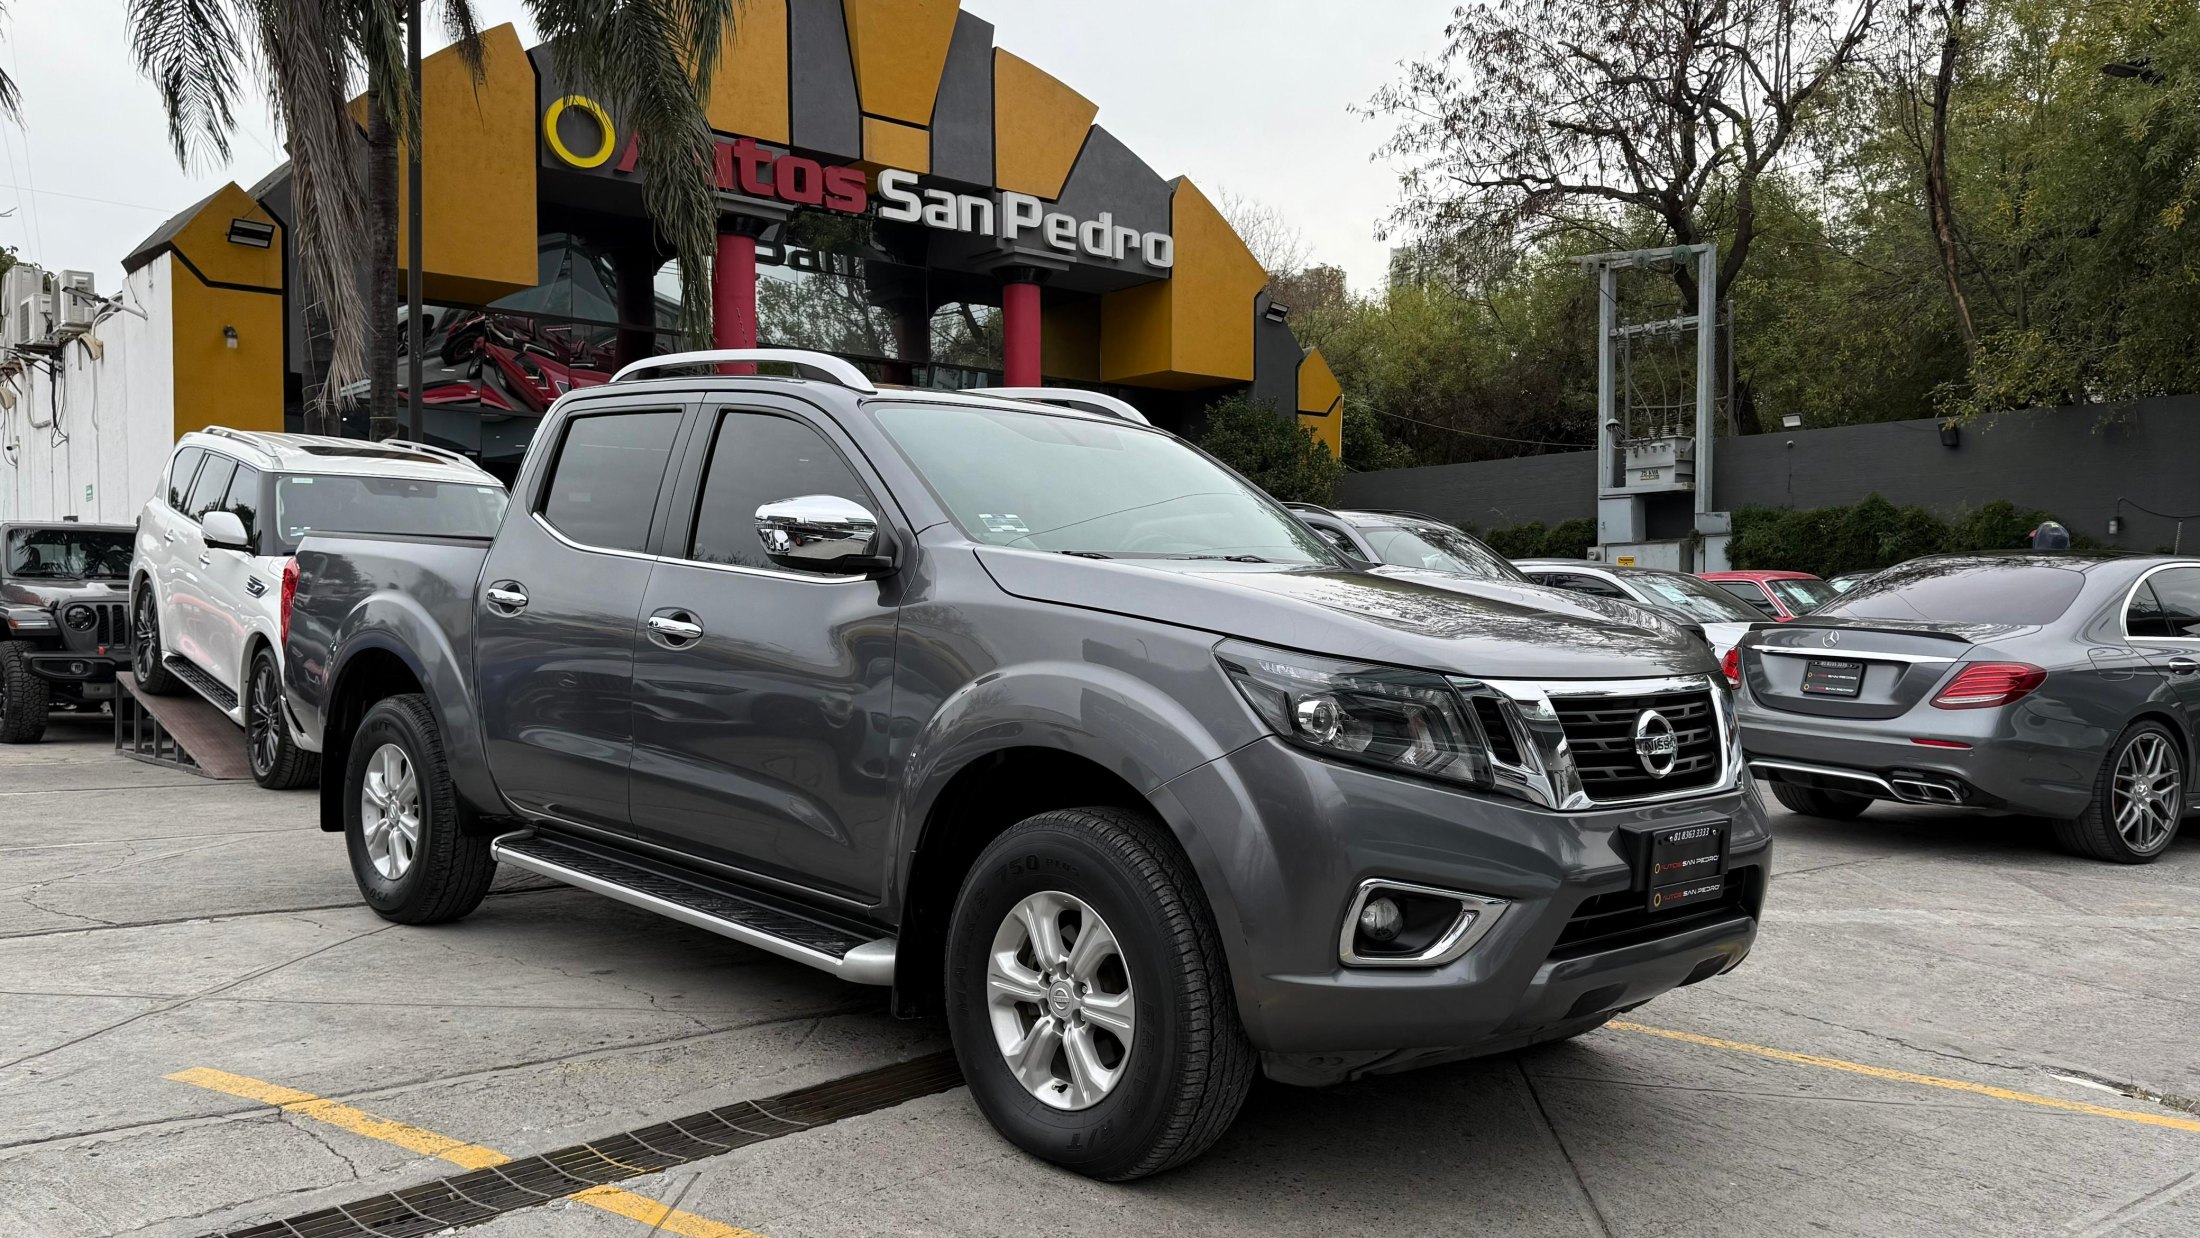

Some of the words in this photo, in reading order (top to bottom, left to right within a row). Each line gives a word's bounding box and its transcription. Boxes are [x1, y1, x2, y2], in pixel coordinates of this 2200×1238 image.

[614, 131, 867, 214] utos
[877, 168, 994, 236] San
[1002, 190, 1174, 268] Pedro
[1695, 827, 1710, 838] 3333
[1682, 859, 1696, 867] SAN
[1696, 855, 1719, 864] PEDRO
[1682, 889, 1697, 897] SAN
[1697, 884, 1720, 894] PEDRO
